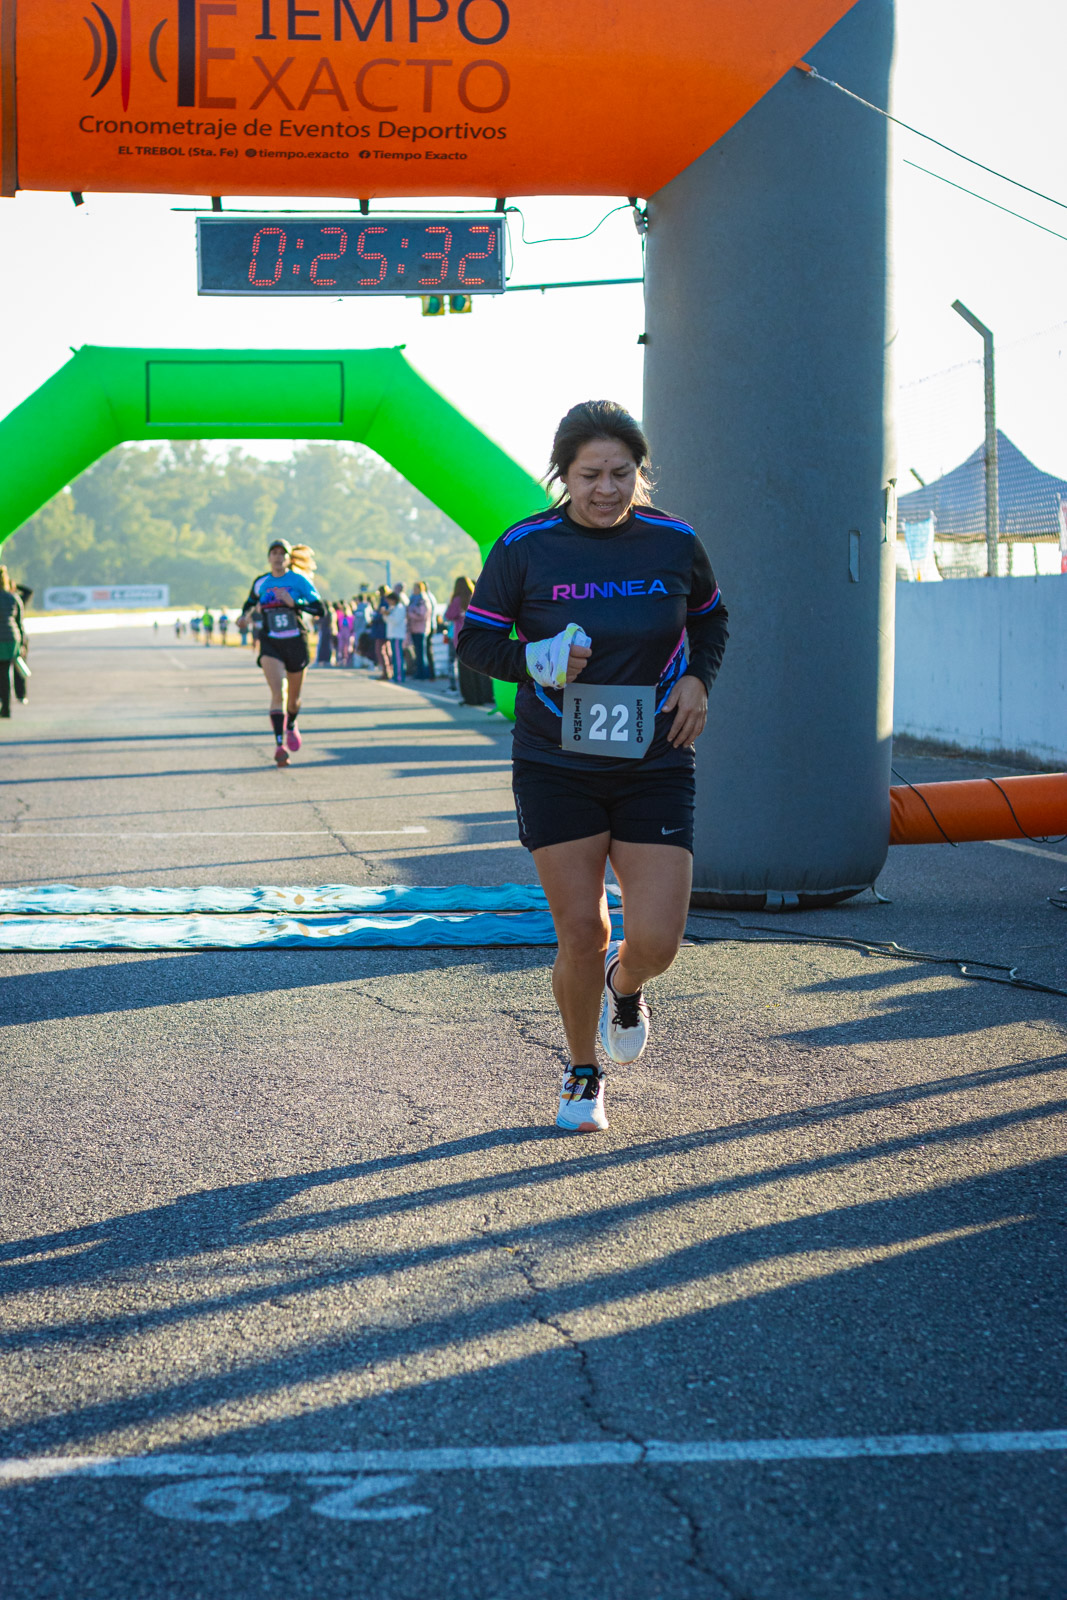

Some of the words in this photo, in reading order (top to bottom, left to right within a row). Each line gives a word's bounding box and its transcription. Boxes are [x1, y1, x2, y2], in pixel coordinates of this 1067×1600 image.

[79, 115, 237, 140] Cronometraje
[243, 118, 273, 137] de
[279, 119, 371, 139] Eventos
[378, 121, 507, 143] Deportivos
[118, 146, 133, 156] EL
[135, 146, 185, 157] TREBOL
[188, 147, 217, 158] (Sta.
[219, 148, 239, 159] Fe)
[373, 150, 422, 162] Tiempo
[425, 151, 468, 161] Exacto
[248, 226, 496, 287] 0:25:32
[552, 579, 669, 601] RUNNEA
[573, 697, 582, 741] TIEMPO
[588, 703, 629, 742] 22
[636, 698, 644, 744] EXACTO
